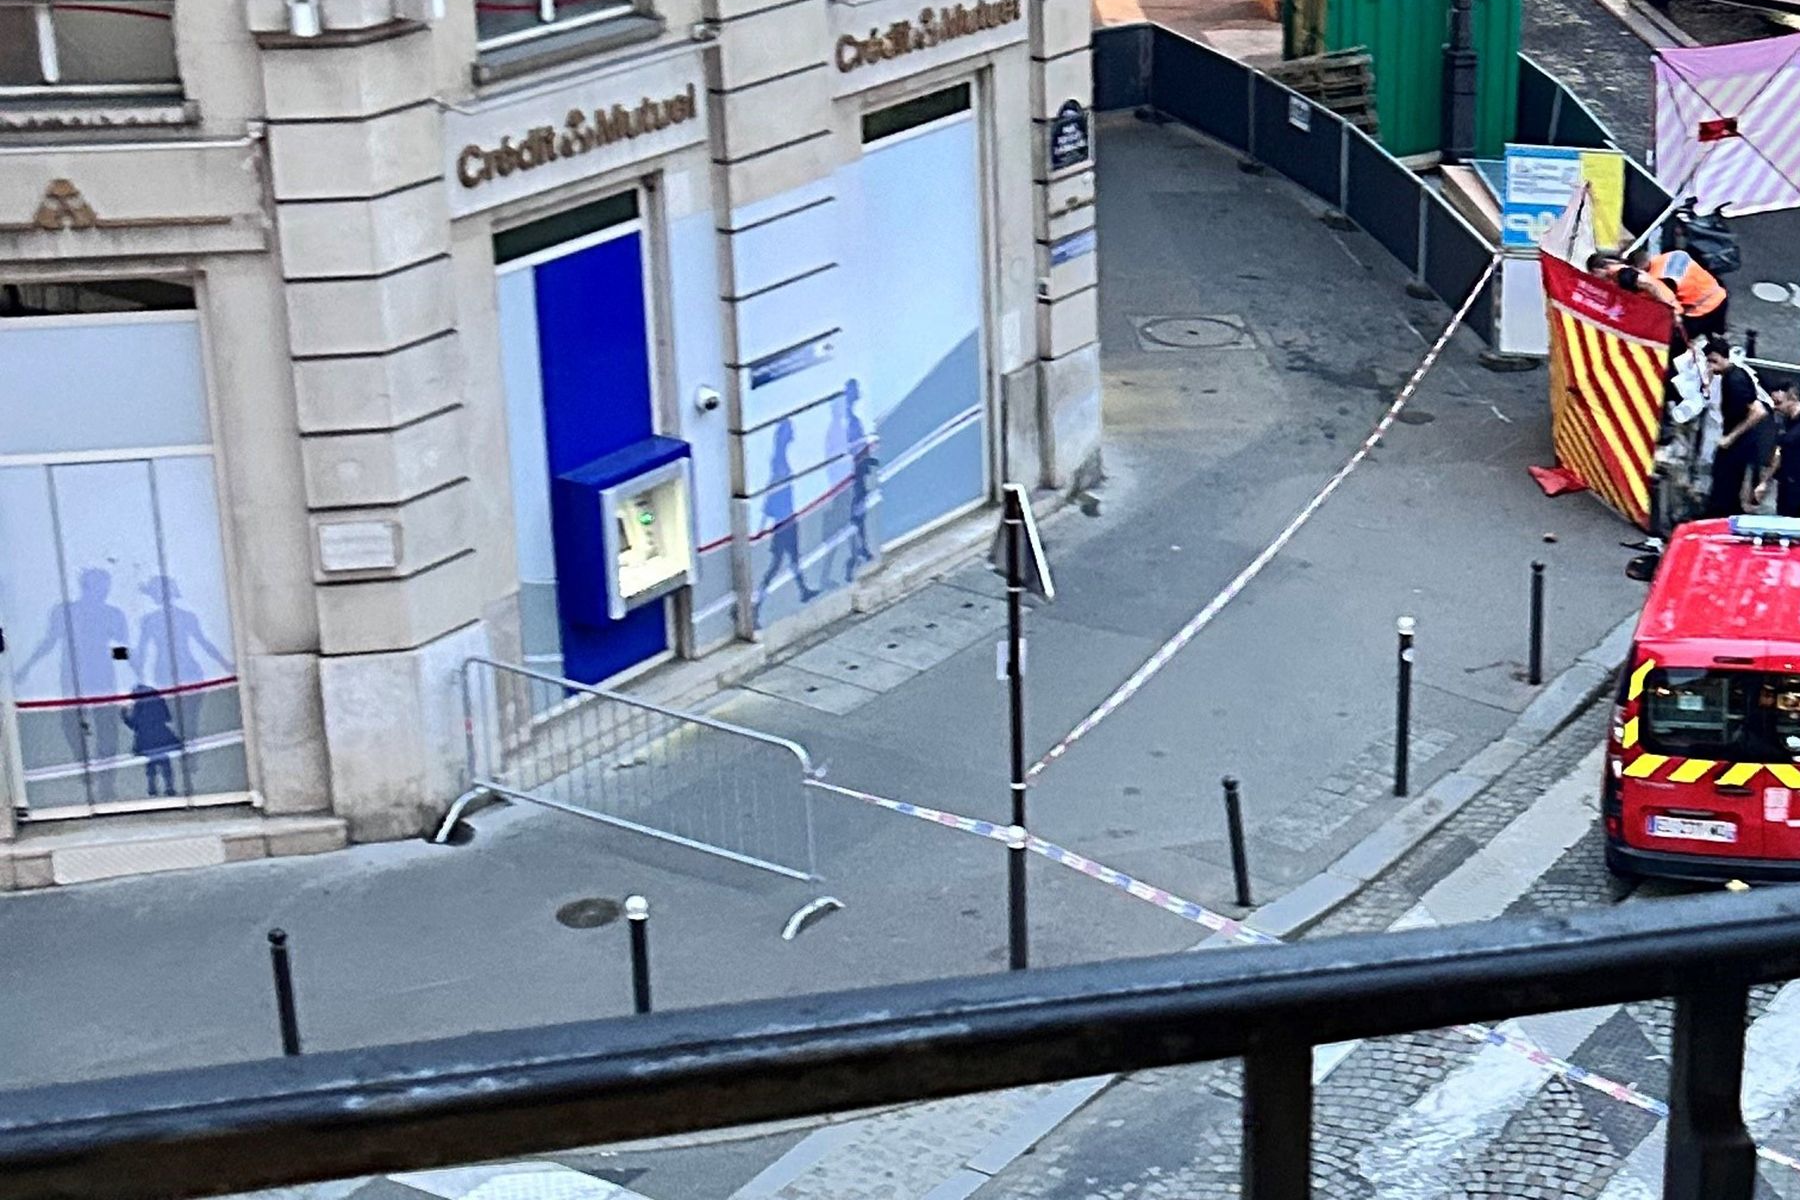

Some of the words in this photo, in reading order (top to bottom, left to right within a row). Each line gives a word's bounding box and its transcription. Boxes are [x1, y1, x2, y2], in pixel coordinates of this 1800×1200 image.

[835, 19, 912, 73] Crédit
[458, 126, 557, 188] Crédit
[594, 82, 696, 145] Mutuel
